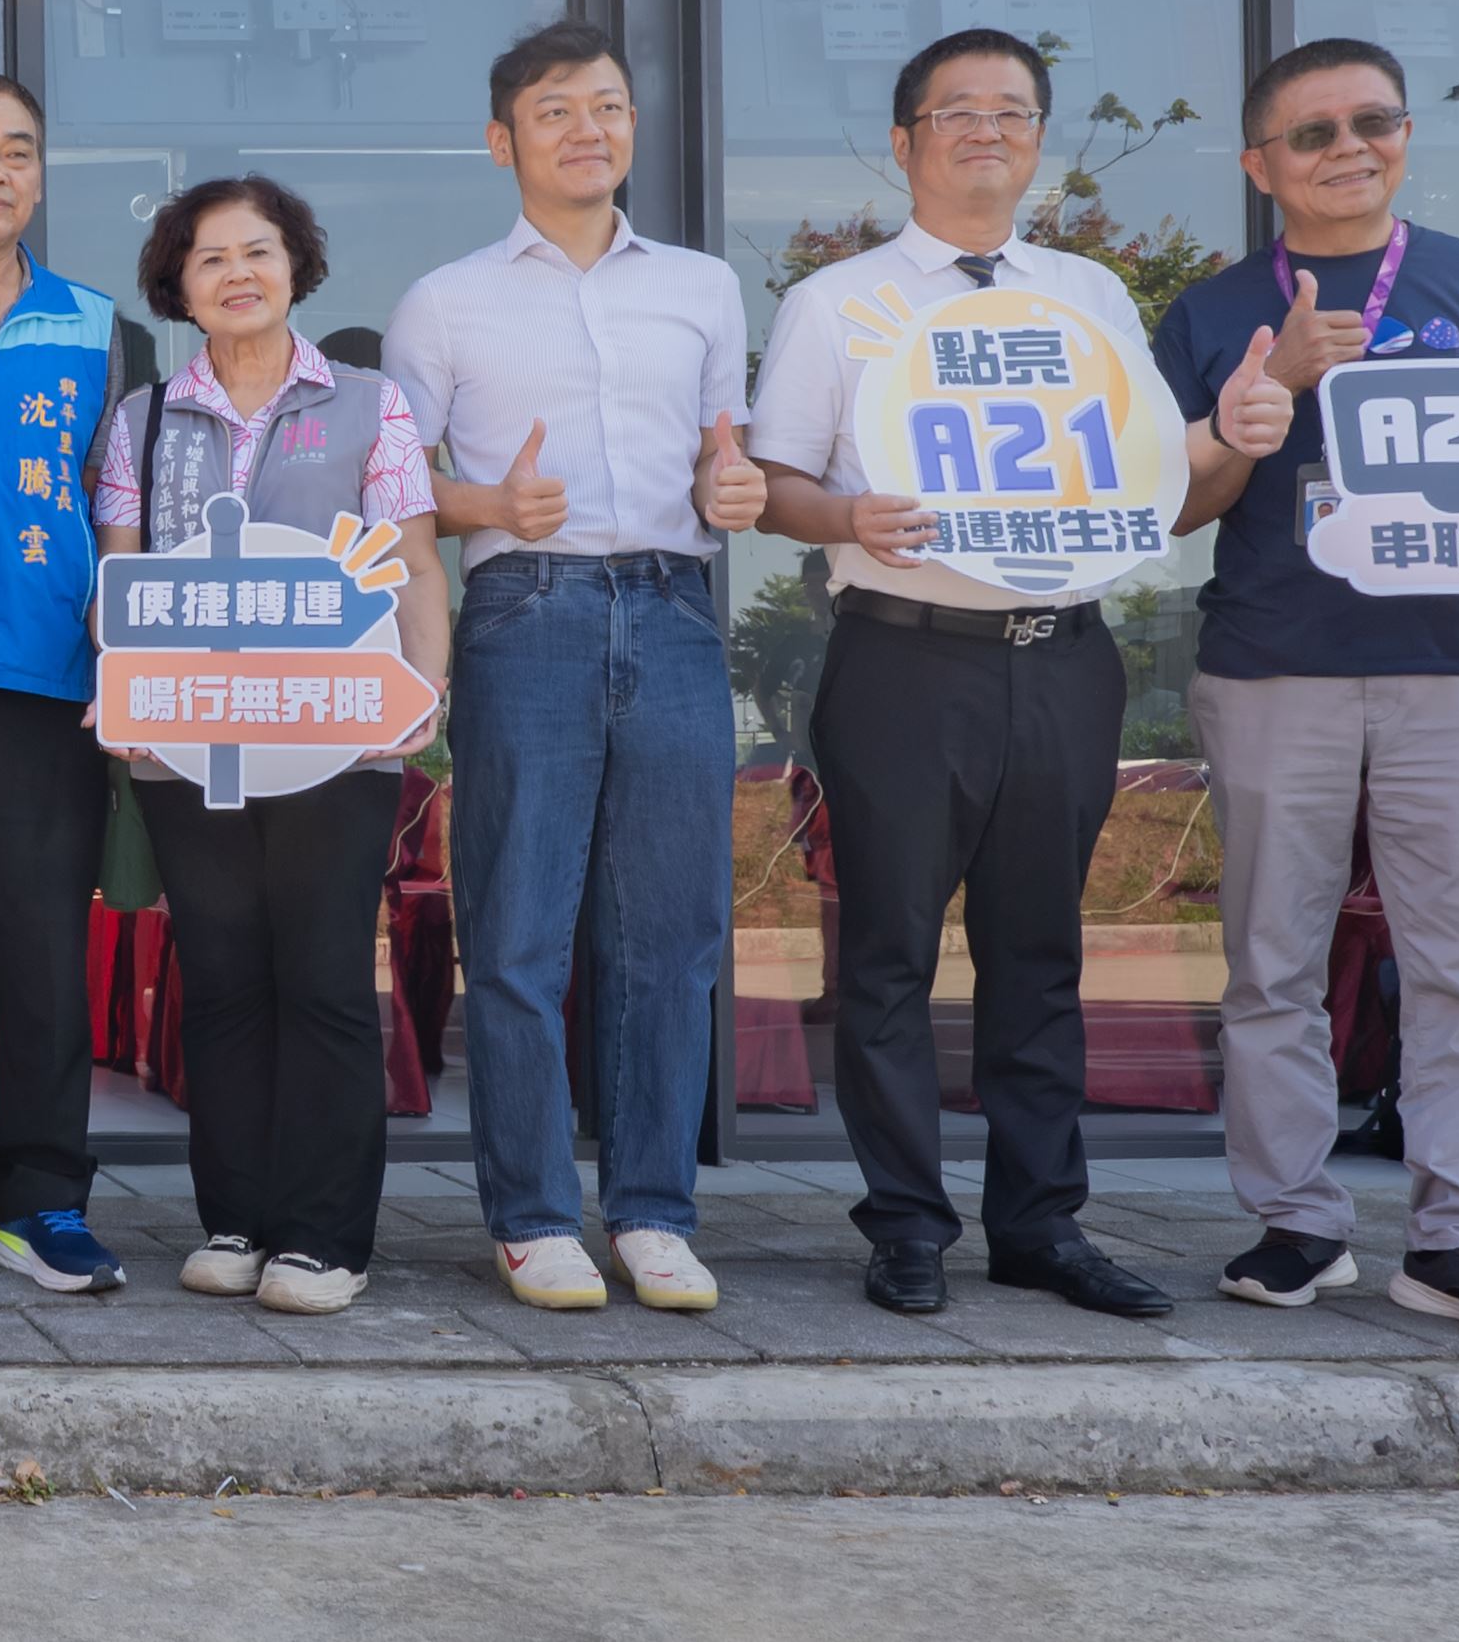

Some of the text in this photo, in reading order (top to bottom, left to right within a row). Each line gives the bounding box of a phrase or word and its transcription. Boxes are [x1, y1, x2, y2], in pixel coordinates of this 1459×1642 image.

[931, 329, 1069, 386] 點亮
[909, 399, 1119, 493] A21
[126, 580, 343, 628] 便捷轉運
[128, 675, 384, 724] 暢行無界限
